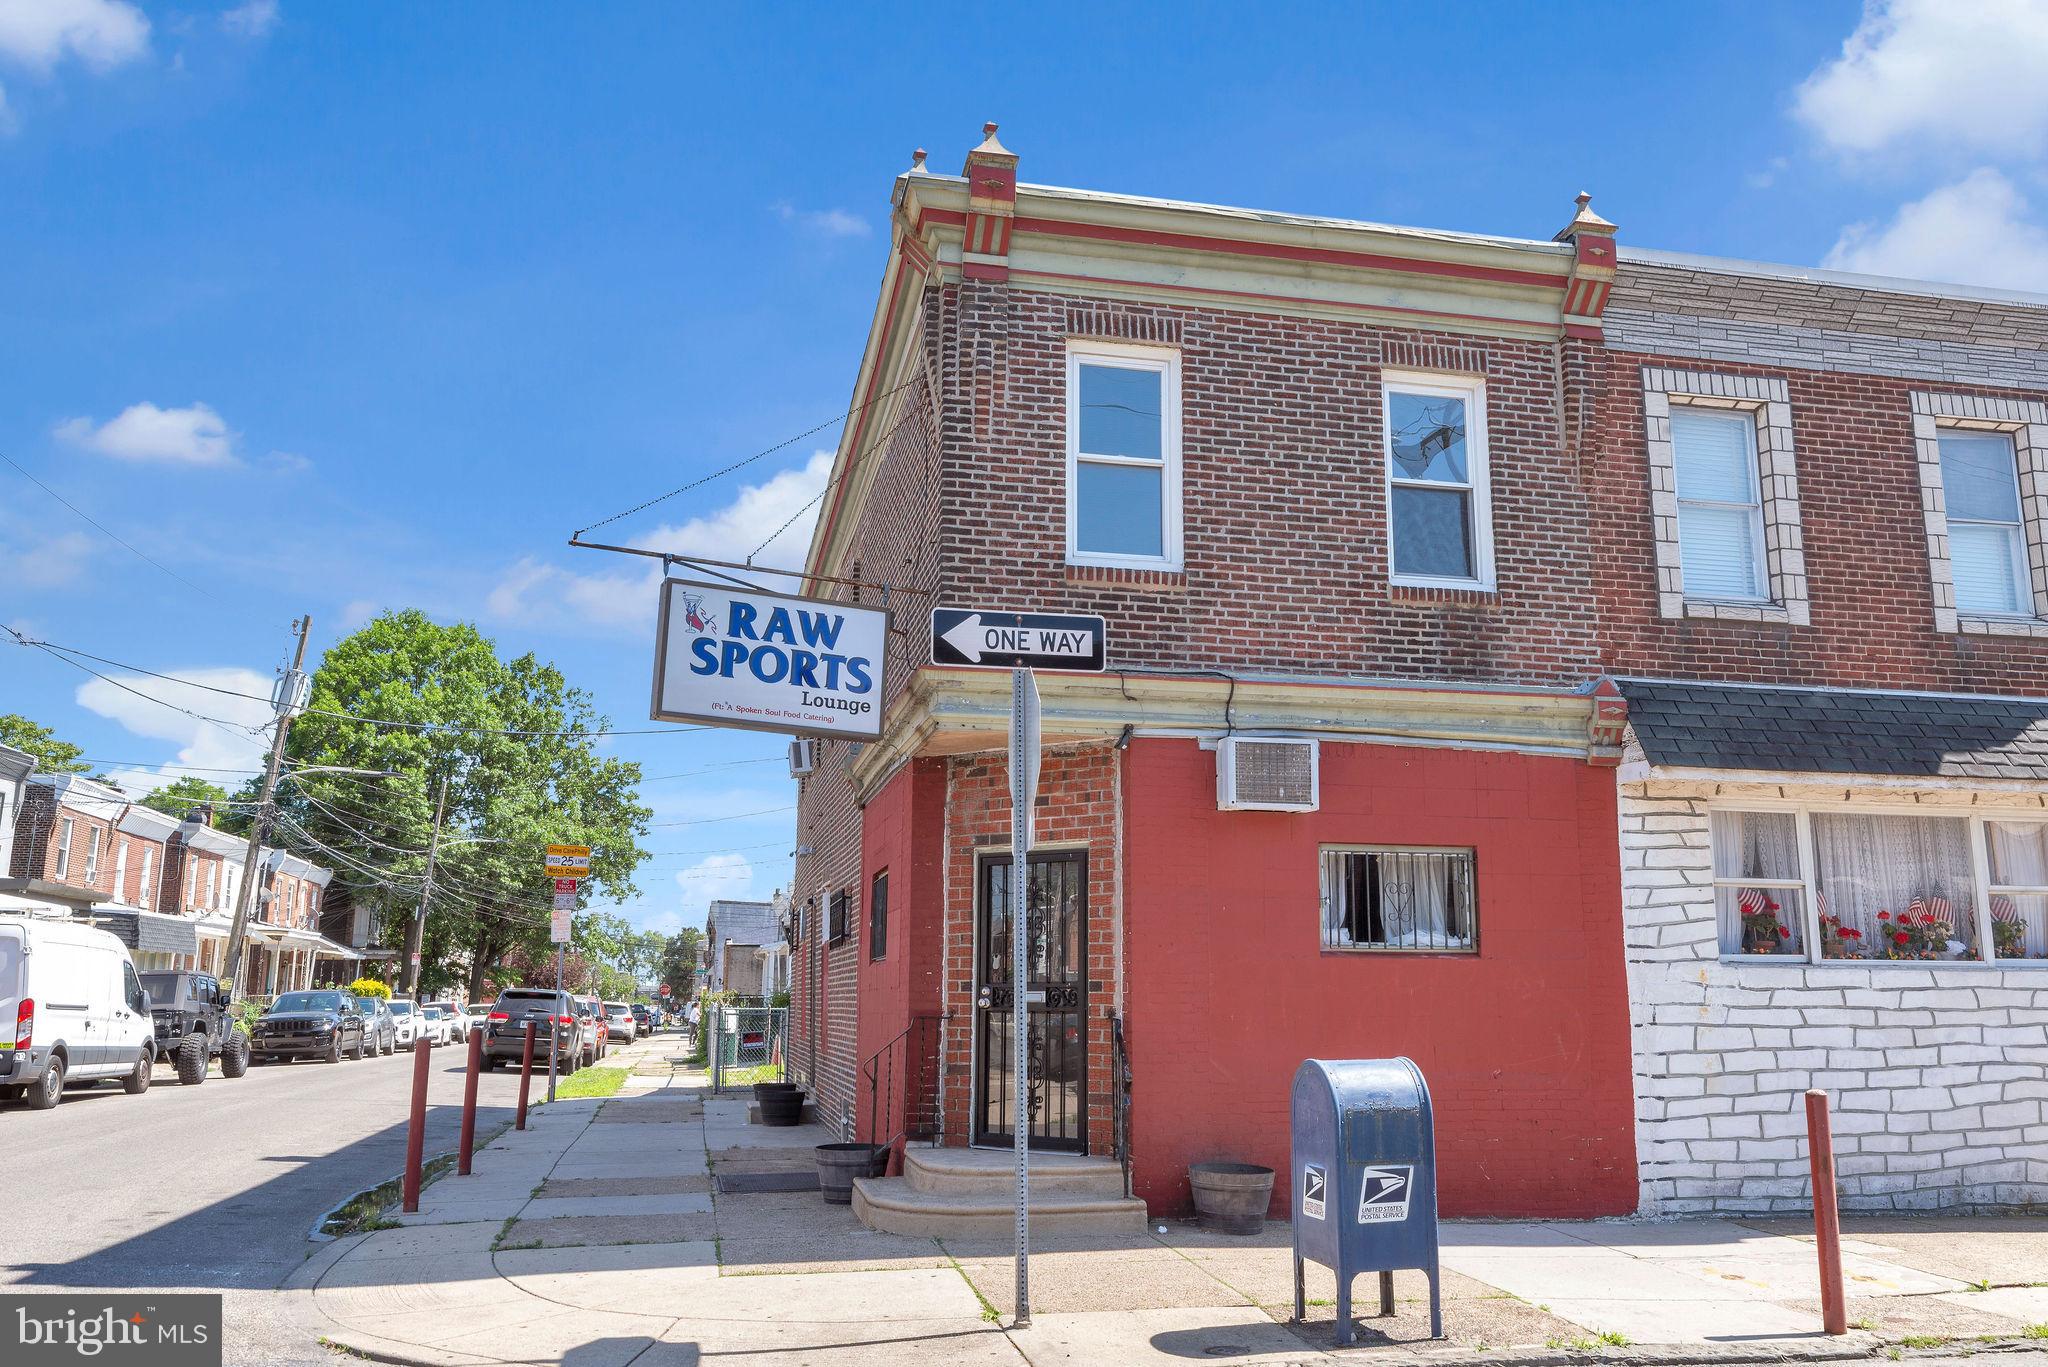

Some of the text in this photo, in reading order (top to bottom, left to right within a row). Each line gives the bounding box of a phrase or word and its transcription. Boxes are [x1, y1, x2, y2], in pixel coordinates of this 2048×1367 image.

[727, 600, 845, 651] RAW
[985, 628, 1086, 654] ONE WAY
[689, 636, 873, 695] SPORTS
[735, 705, 762, 714] Spoken
[764, 708, 781, 717] Soul
[783, 710, 800, 719] Food
[803, 712, 835, 723] Catering)
[801, 691, 871, 715] Lounge
[560, 856, 574, 866] 25
